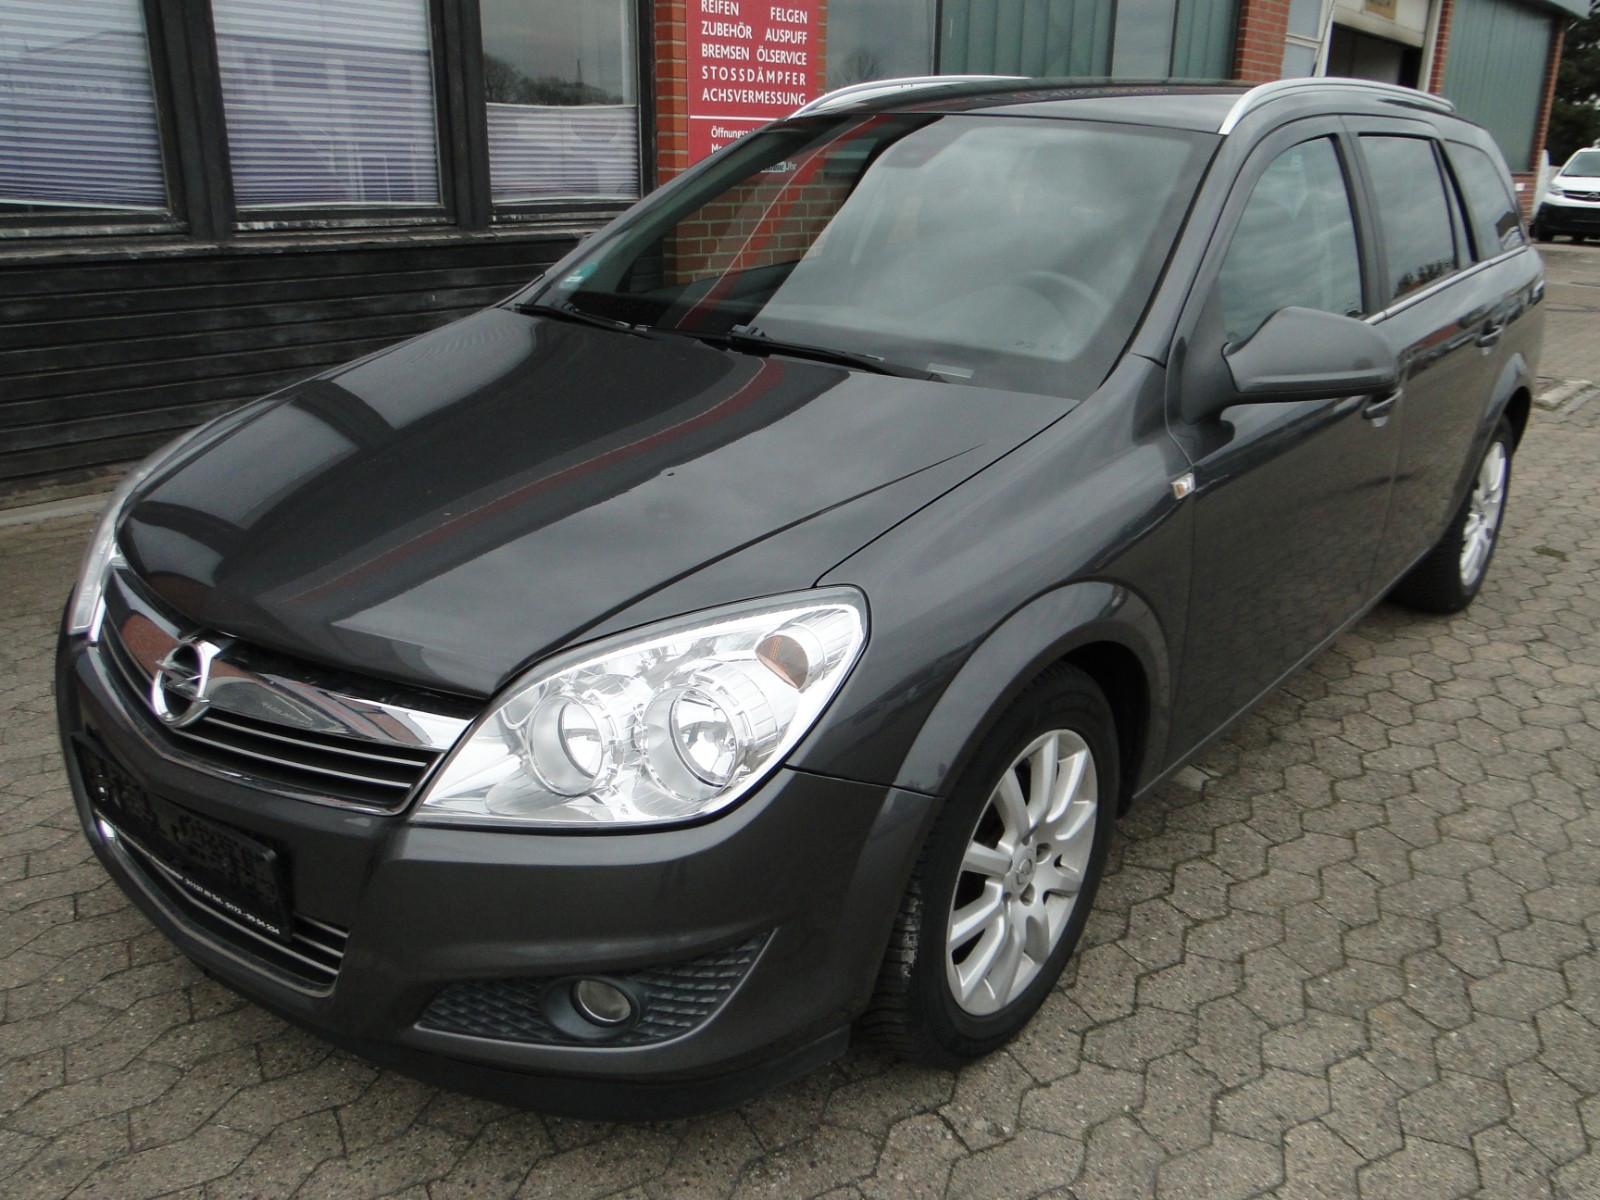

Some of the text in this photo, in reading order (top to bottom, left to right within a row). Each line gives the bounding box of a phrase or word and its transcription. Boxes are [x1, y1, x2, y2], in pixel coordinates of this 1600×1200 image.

[701, 0, 808, 24] REIFEN FELGEN
[701, 21, 808, 45] ZUBEHÖR AUSPUFF
[701, 43, 807, 65] BREMSEN ÖLSERVICE
[702, 65, 806, 85] STOSSDÄMPFER
[702, 88, 806, 105] ACHSVERMESSUNG
